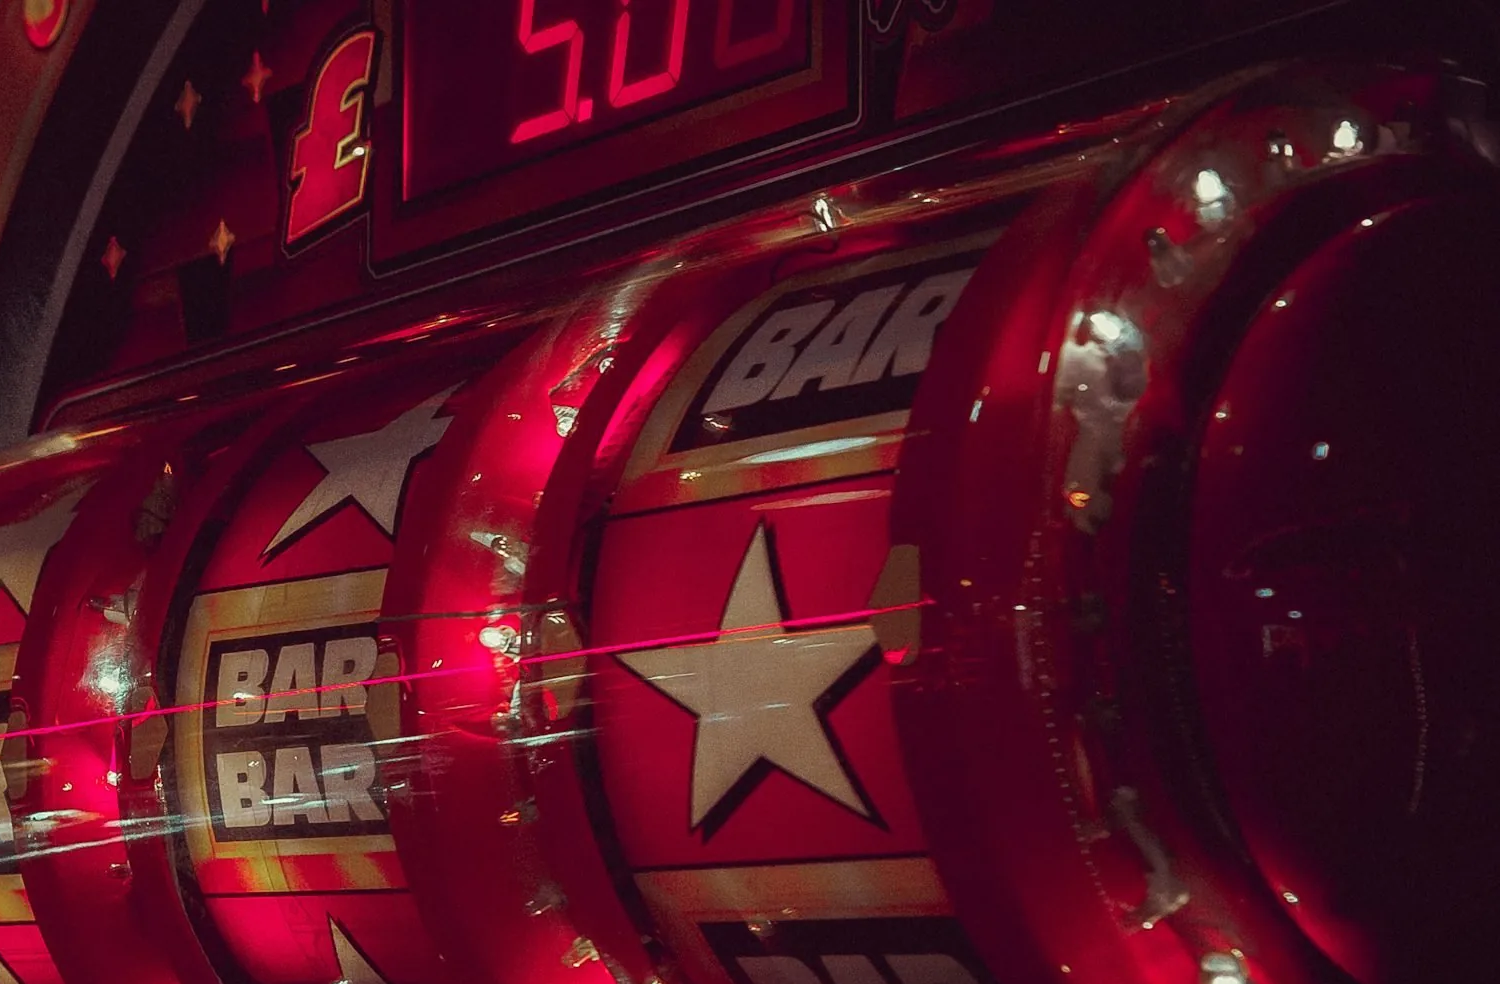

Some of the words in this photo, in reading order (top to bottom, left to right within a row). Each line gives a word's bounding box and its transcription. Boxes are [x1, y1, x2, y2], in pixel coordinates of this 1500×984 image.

[286, 31, 376, 245] £
[701, 266, 973, 414] BAR
[217, 636, 377, 728] BAR
[217, 744, 386, 829] BAR
